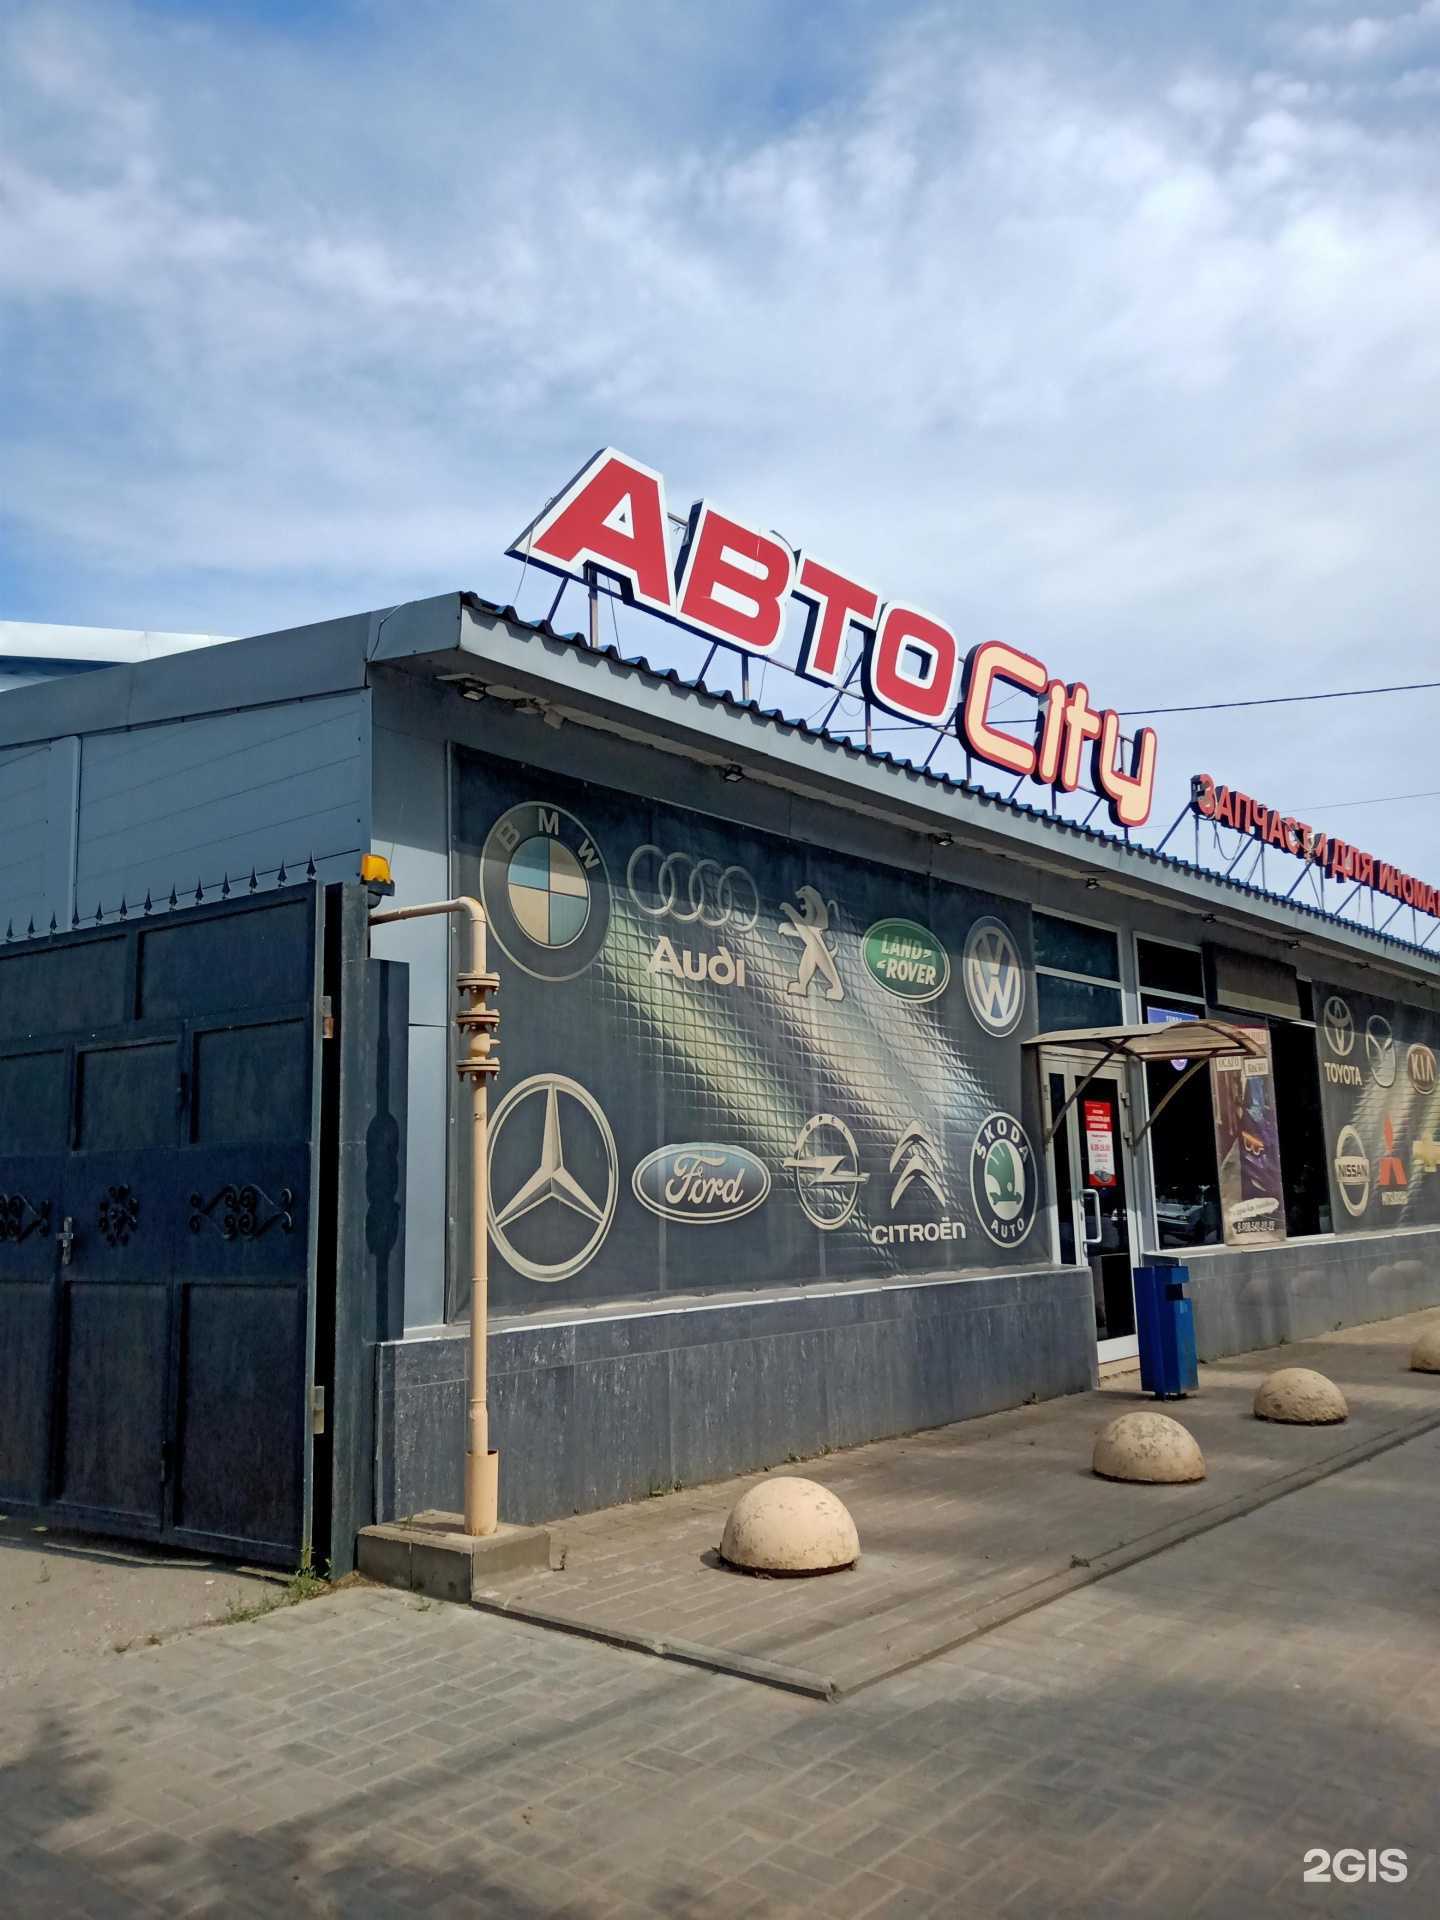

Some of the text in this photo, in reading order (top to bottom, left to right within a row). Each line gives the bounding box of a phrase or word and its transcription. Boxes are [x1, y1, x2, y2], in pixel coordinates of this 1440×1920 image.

[957, 640, 1157, 827] City
[496, 808, 601, 870] BMW
[1330, 838, 1374, 886] ДЛЯ
[646, 935, 746, 987] Audi
[881, 933, 923, 960] LAND
[886, 957, 937, 986] ROVER
[1324, 1061, 1362, 1087] TOYOTA
[1411, 1053, 1435, 1082] KIA
[664, 1152, 746, 1205] Ford
[1337, 1163, 1369, 1178] NISSAN
[991, 1217, 1025, 1238] AUTO
